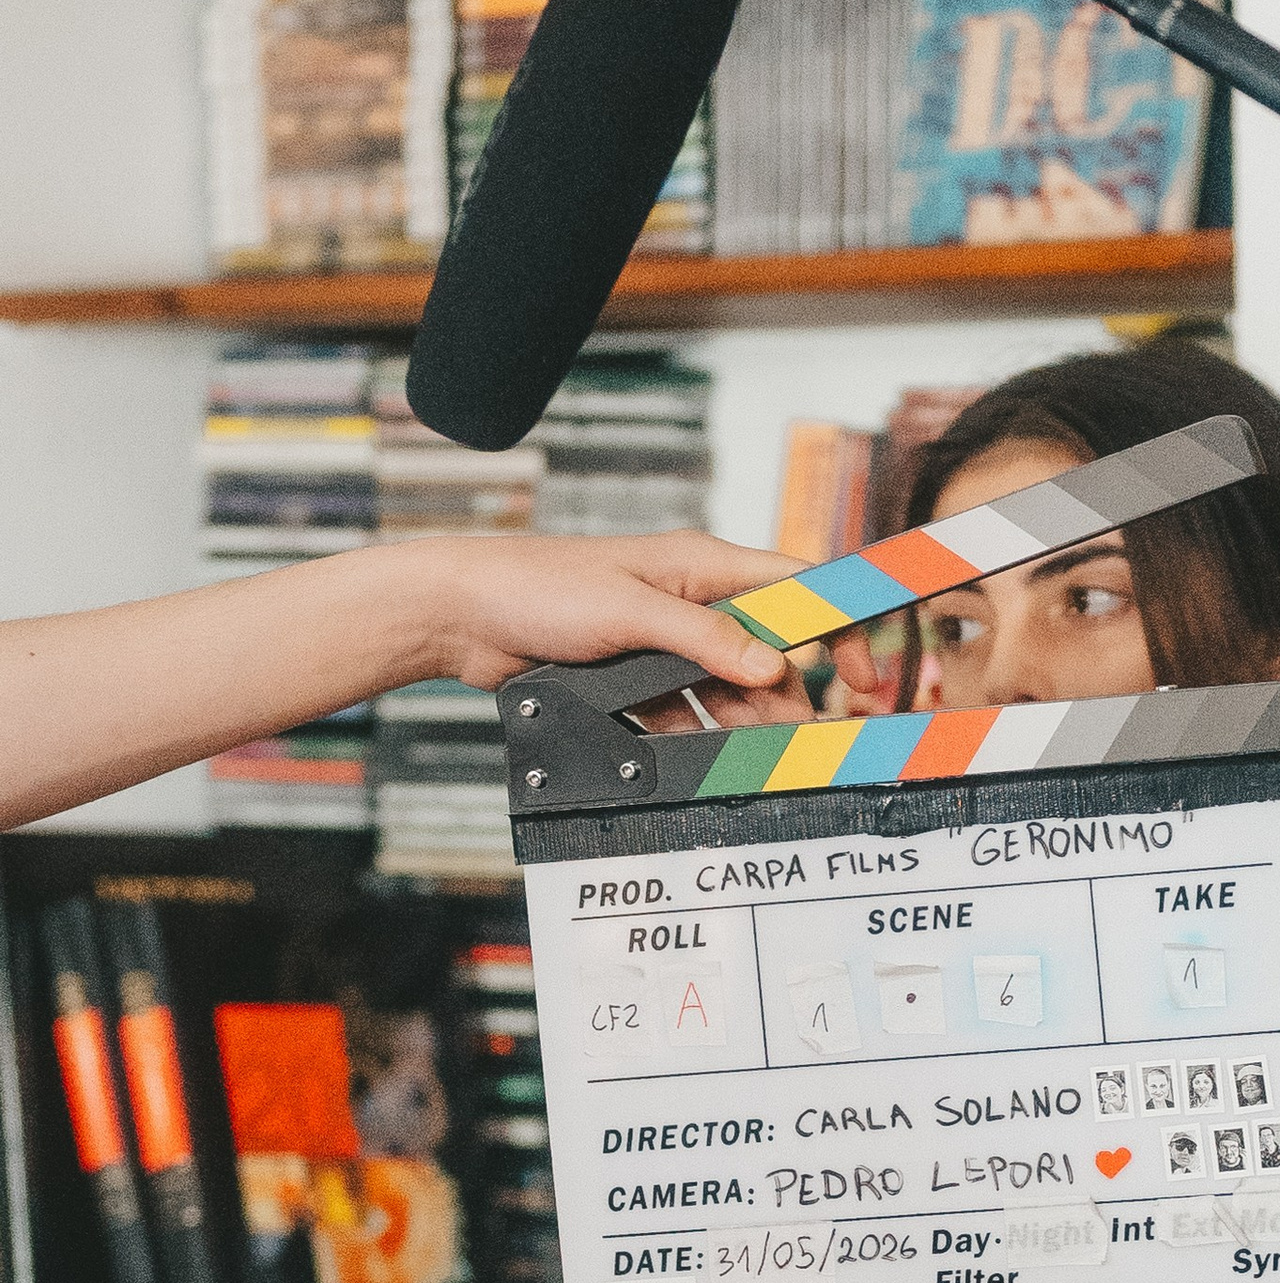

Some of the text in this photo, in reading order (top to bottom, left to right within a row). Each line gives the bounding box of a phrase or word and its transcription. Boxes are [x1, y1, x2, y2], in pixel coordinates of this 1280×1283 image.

[578, 878, 673, 910] PROD.
[695, 853, 807, 893] CARPA
[825, 848, 920, 881] FILMS
[1154, 881, 1237, 914] TAKE
[867, 901, 974, 936] SCENE
[628, 922, 707, 954] ROLL
[999, 973, 1015, 1007] 6
[1183, 957, 1199, 990] 1
[676, 981, 708, 1030] A
[602, 1085, 1082, 1155] DIRECTOR: CARLA SOLANO
[606, 1151, 1074, 1213] CAMERA: PEDRO LEPORI
[1111, 1216, 1156, 1243] Int
[613, 1227, 918, 1277] DATE: 31/05/2026
